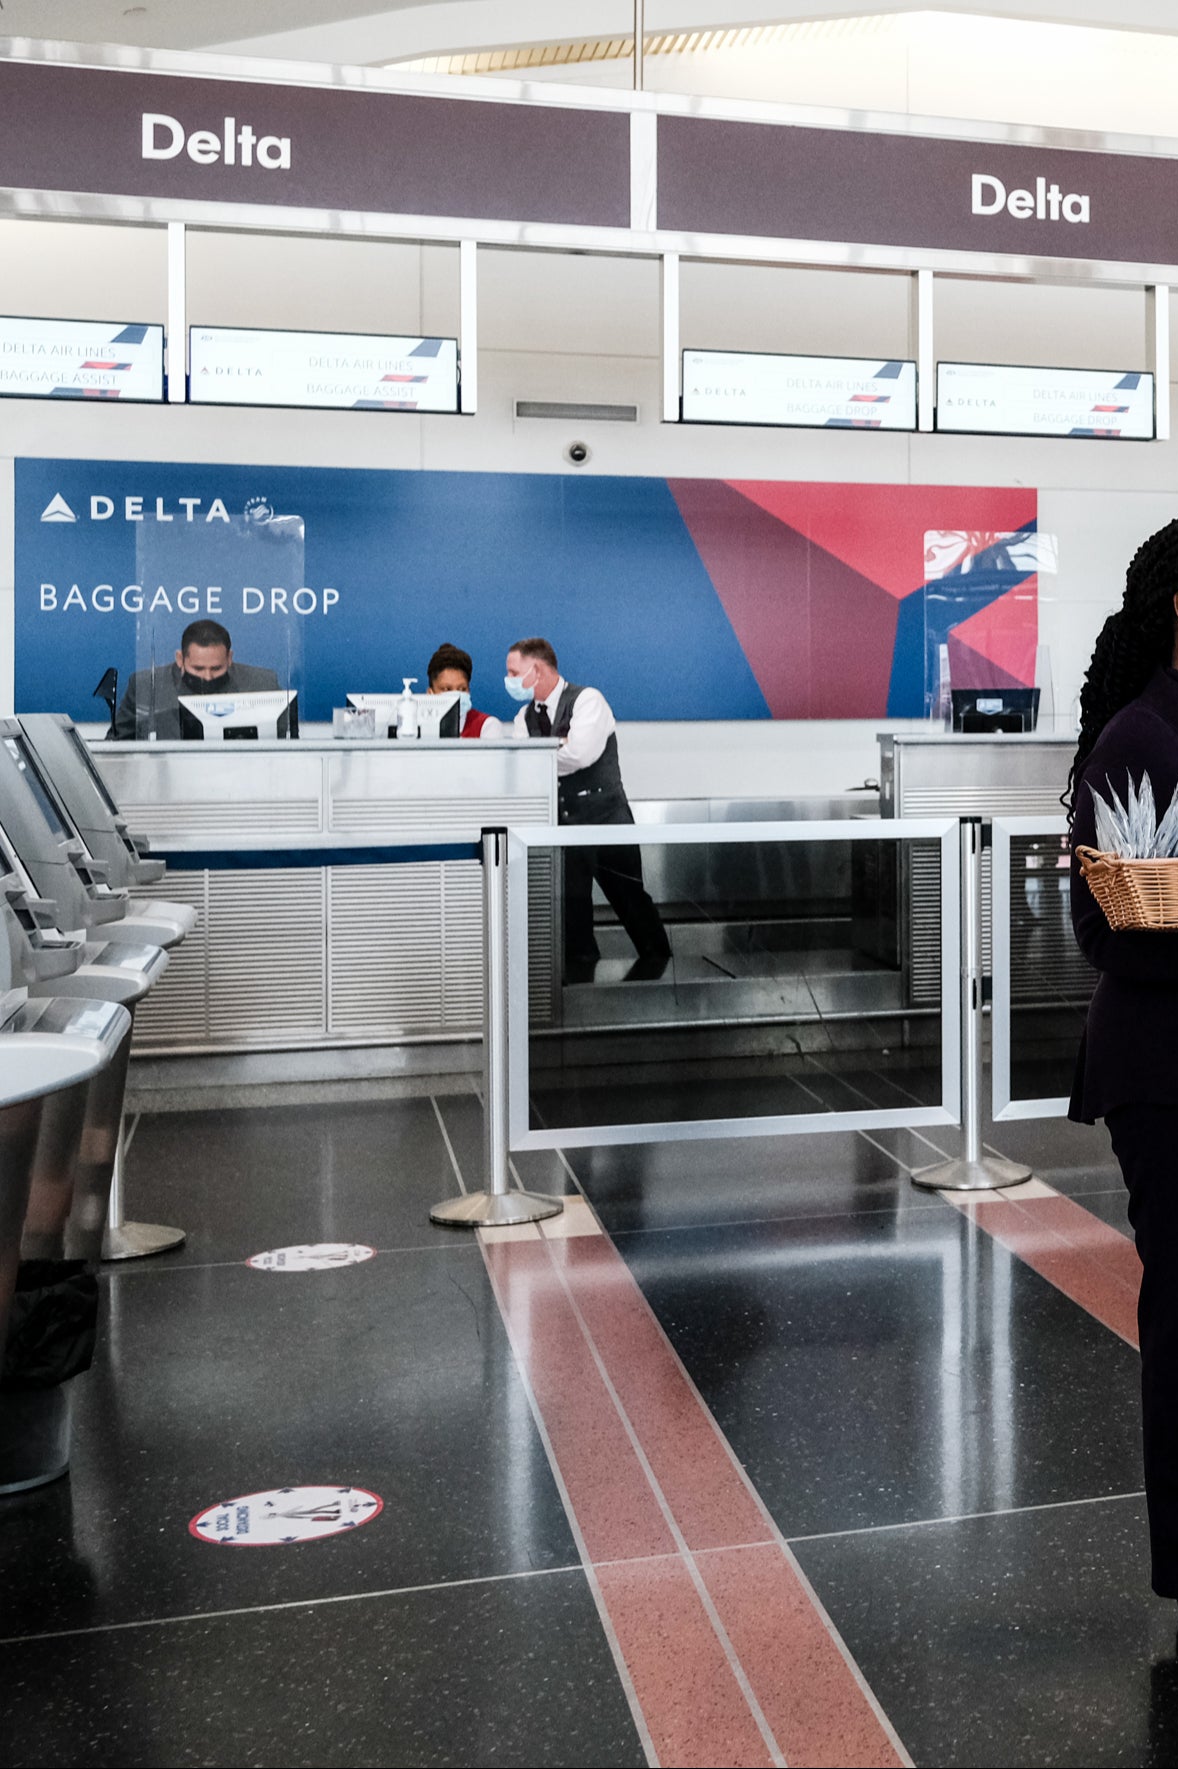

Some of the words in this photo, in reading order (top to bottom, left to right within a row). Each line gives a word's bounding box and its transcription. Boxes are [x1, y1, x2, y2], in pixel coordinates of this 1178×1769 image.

[142, 113, 291, 170] Delta
[971, 173, 1090, 223] Delta
[2, 341, 46, 354] DELTA
[50, 345, 73, 357] AIR
[77, 346, 117, 358] LINES
[215, 366, 263, 377] DELTA
[308, 356, 349, 369] DELTA
[352, 358, 375, 370] AIR
[378, 359, 414, 372] LINES
[0, 369, 69, 385] BAGGAGE
[72, 372, 118, 386] ASSIST
[786, 377, 822, 390] DELTA
[825, 379, 845, 391] AIR
[847, 380, 878, 393] LINES
[306, 383, 368, 397] BAGGAGE
[372, 385, 416, 399] ASSIST
[705, 386, 747, 397] DELTA
[1033, 389, 1066, 400] DELTA
[1068, 390, 1086, 401] AIR
[1088, 390, 1118, 403] LINES
[786, 402, 842, 415] BAGGAGE
[846, 404, 878, 416] DROP
[957, 398, 996, 408] DELTA
[1033, 413, 1085, 425] BAGGAGE
[1088, 414, 1118, 426] DROP
[90, 495, 231, 523] DELTA
[40, 583, 223, 613] BAGGAGE
[242, 587, 340, 615] DROP
